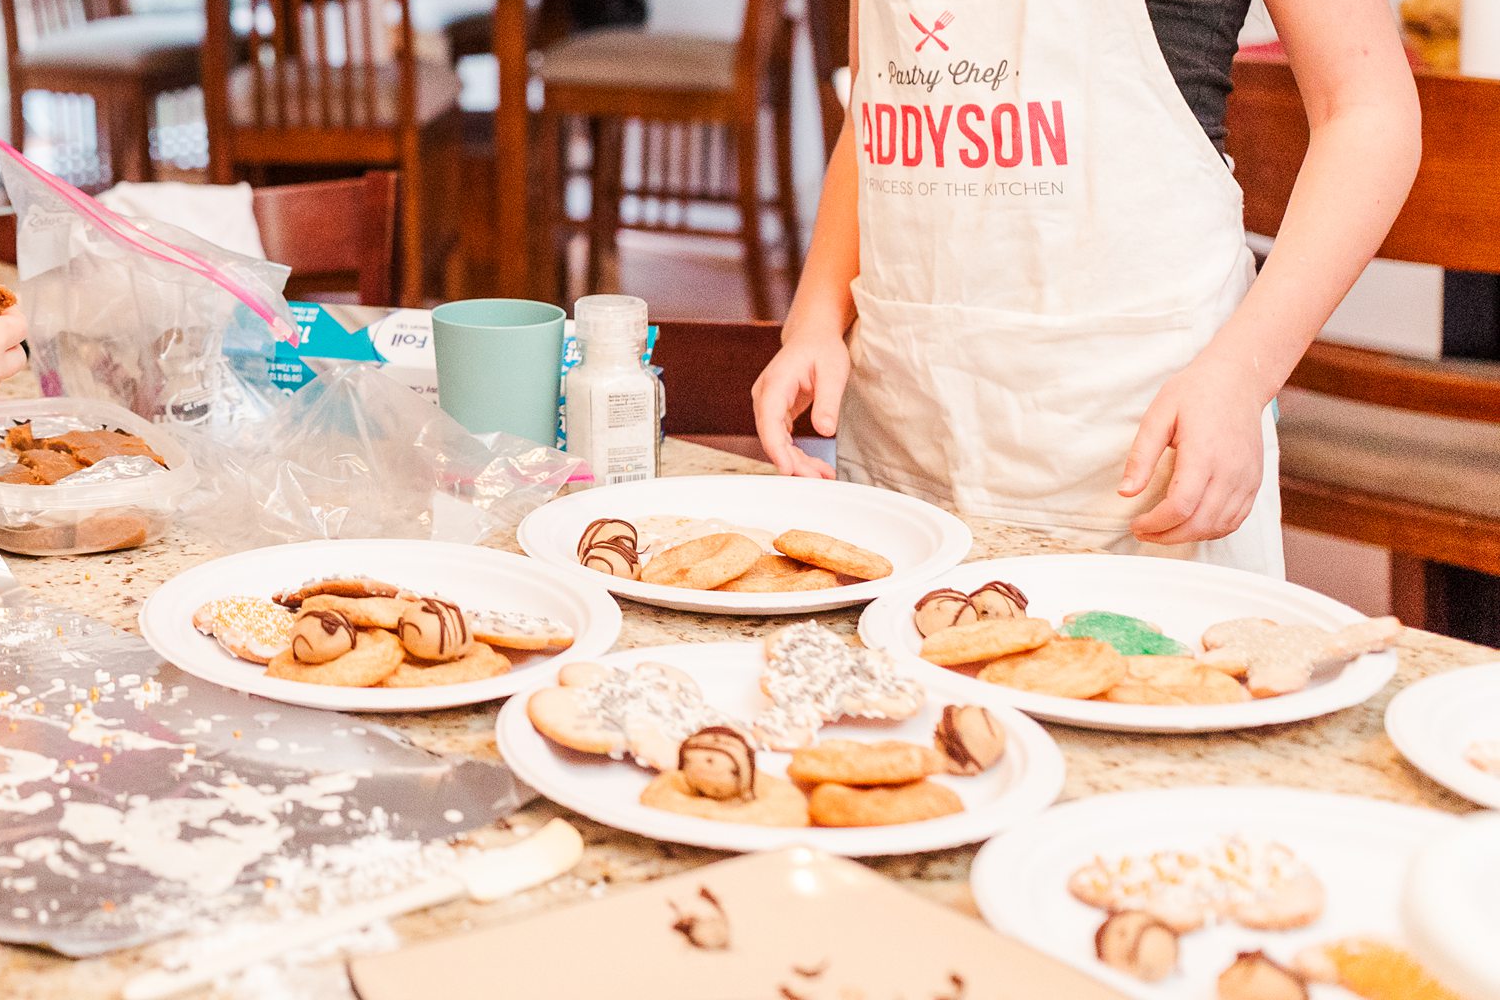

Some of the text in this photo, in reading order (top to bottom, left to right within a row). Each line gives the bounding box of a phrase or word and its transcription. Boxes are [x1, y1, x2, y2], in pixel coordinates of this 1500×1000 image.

[888, 59, 1009, 93] Pastry Chef
[862, 100, 1068, 169] ADDYSON
[918, 181, 938, 196] OF
[945, 182, 978, 196] THE
[984, 180, 1064, 196] KITCHEN
[390, 333, 428, 349] Foil
